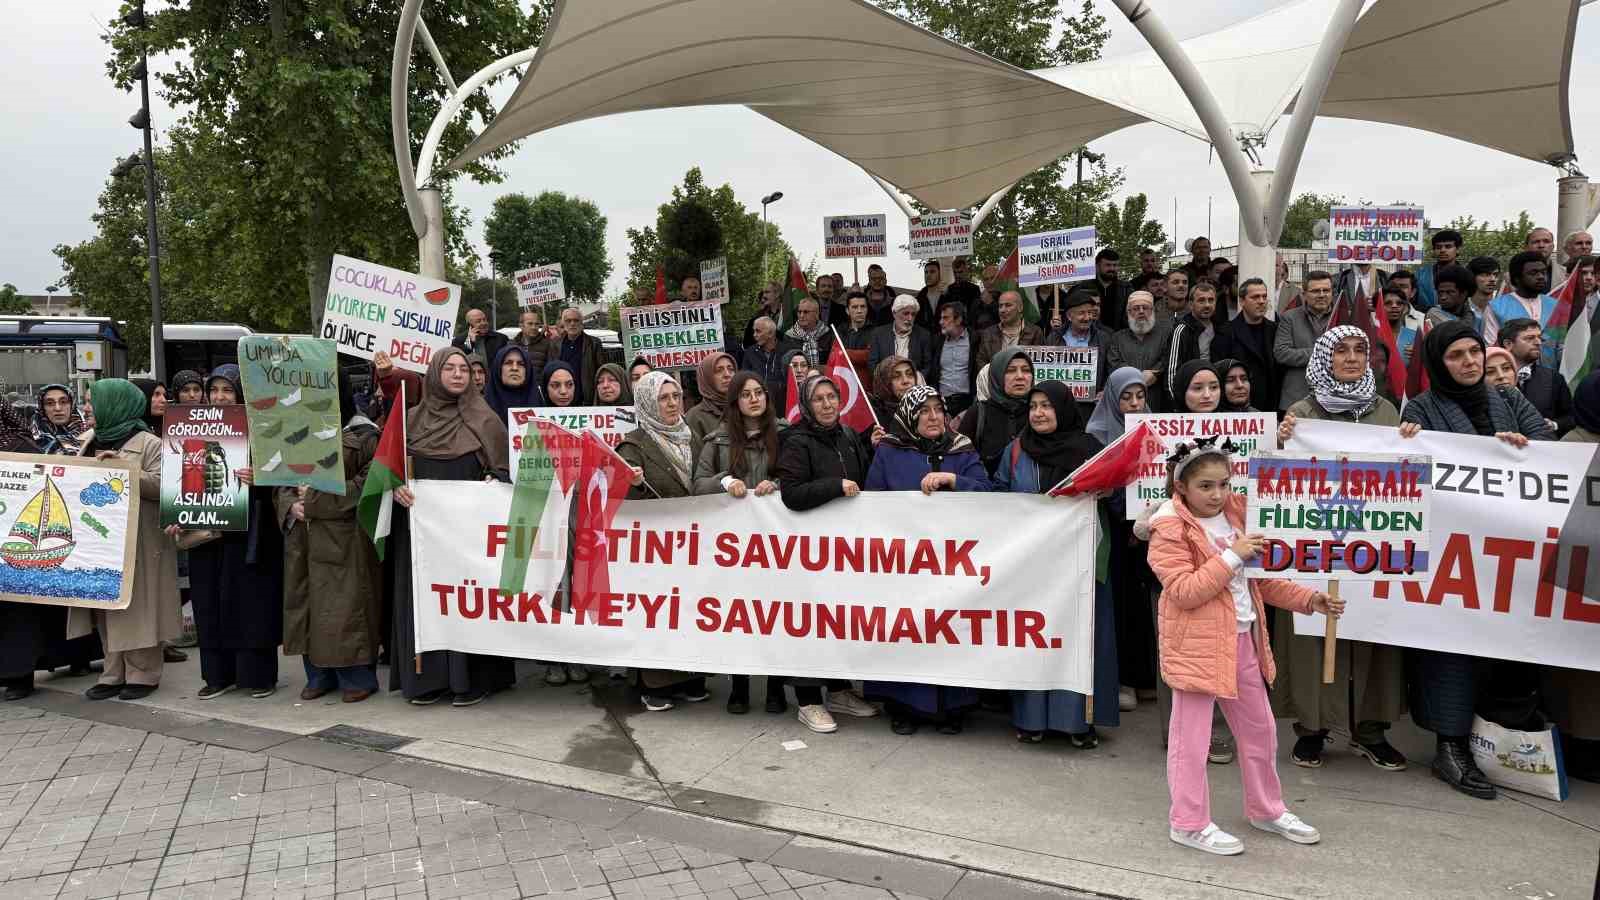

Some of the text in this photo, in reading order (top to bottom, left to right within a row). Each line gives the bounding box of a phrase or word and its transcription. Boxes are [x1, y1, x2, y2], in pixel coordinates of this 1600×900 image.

[1336, 245, 1415, 261] DEFOL!
[326, 292, 452, 340] UYURKEN SUSULUR
[628, 303, 716, 329] FİLİSTİNLİ
[323, 319, 433, 366] ÖLÜNCE DEĞİL
[630, 328, 719, 349] BEBEKLER
[189, 407, 224, 421] SENİN
[1201, 418, 1265, 436] KALMA!
[167, 422, 243, 436] GÖRDÜĞÜN...
[1256, 456, 1423, 502] KATİL İSRAİL
[173, 492, 235, 507] ASLINDA
[178, 510, 229, 525] OLAN...
[1259, 504, 1423, 532] FİLİSTİN'DEN
[713, 531, 991, 587] SAVUNMAK,
[1262, 538, 1416, 575] DEFOL!
[1373, 526, 1600, 625] ATİL
[695, 595, 1064, 650] SAVUNMAKTIR.
